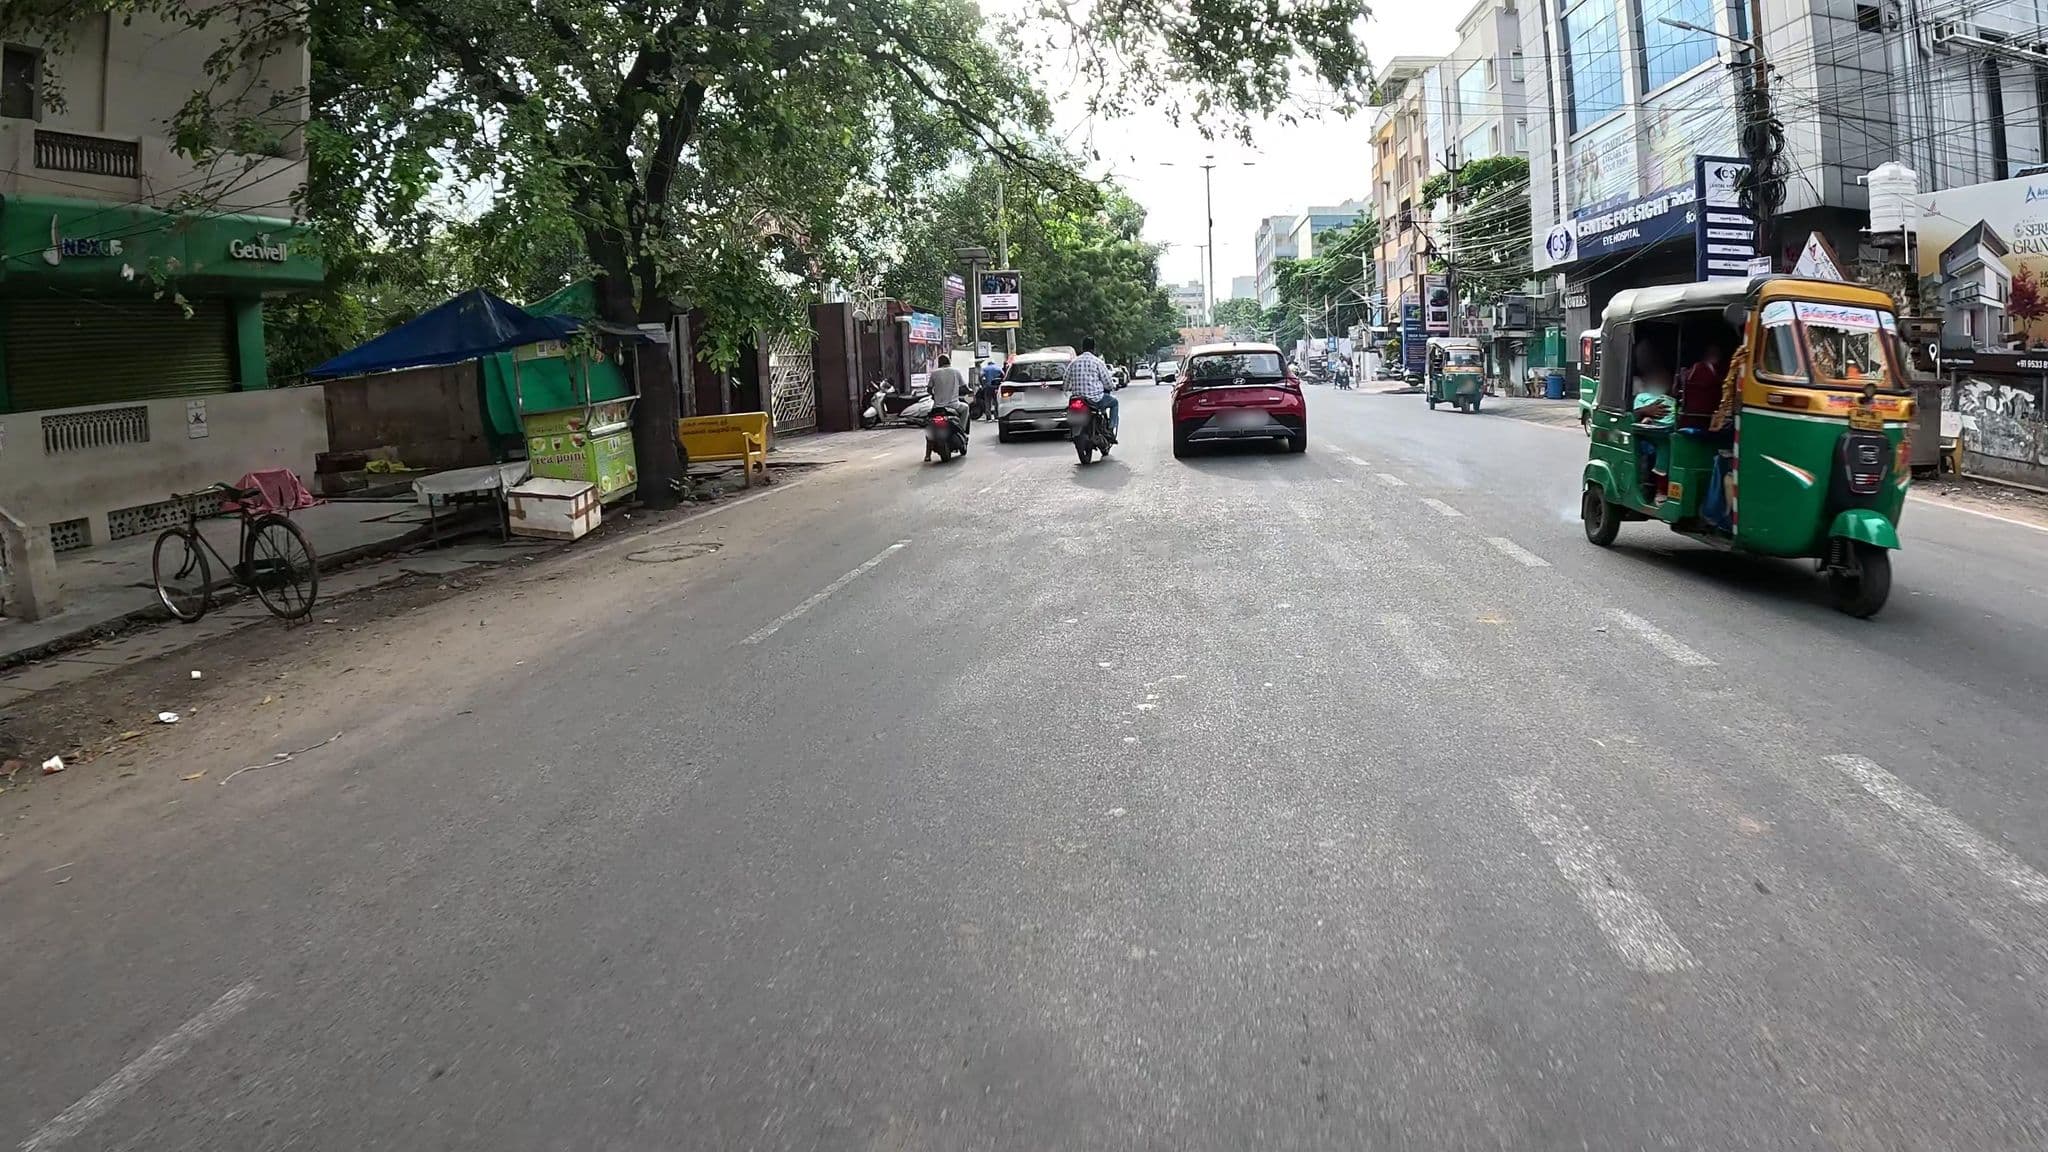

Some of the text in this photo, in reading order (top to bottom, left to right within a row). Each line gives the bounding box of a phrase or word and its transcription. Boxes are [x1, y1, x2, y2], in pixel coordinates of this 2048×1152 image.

[1577, 213, 1614, 237] CENTRE
[1635, 195, 1669, 220] SIGHT
[229, 232, 288, 261] Getwell
[1553, 234, 1565, 251] CS
[1603, 227, 1640, 246] EYE HOSPITAL
